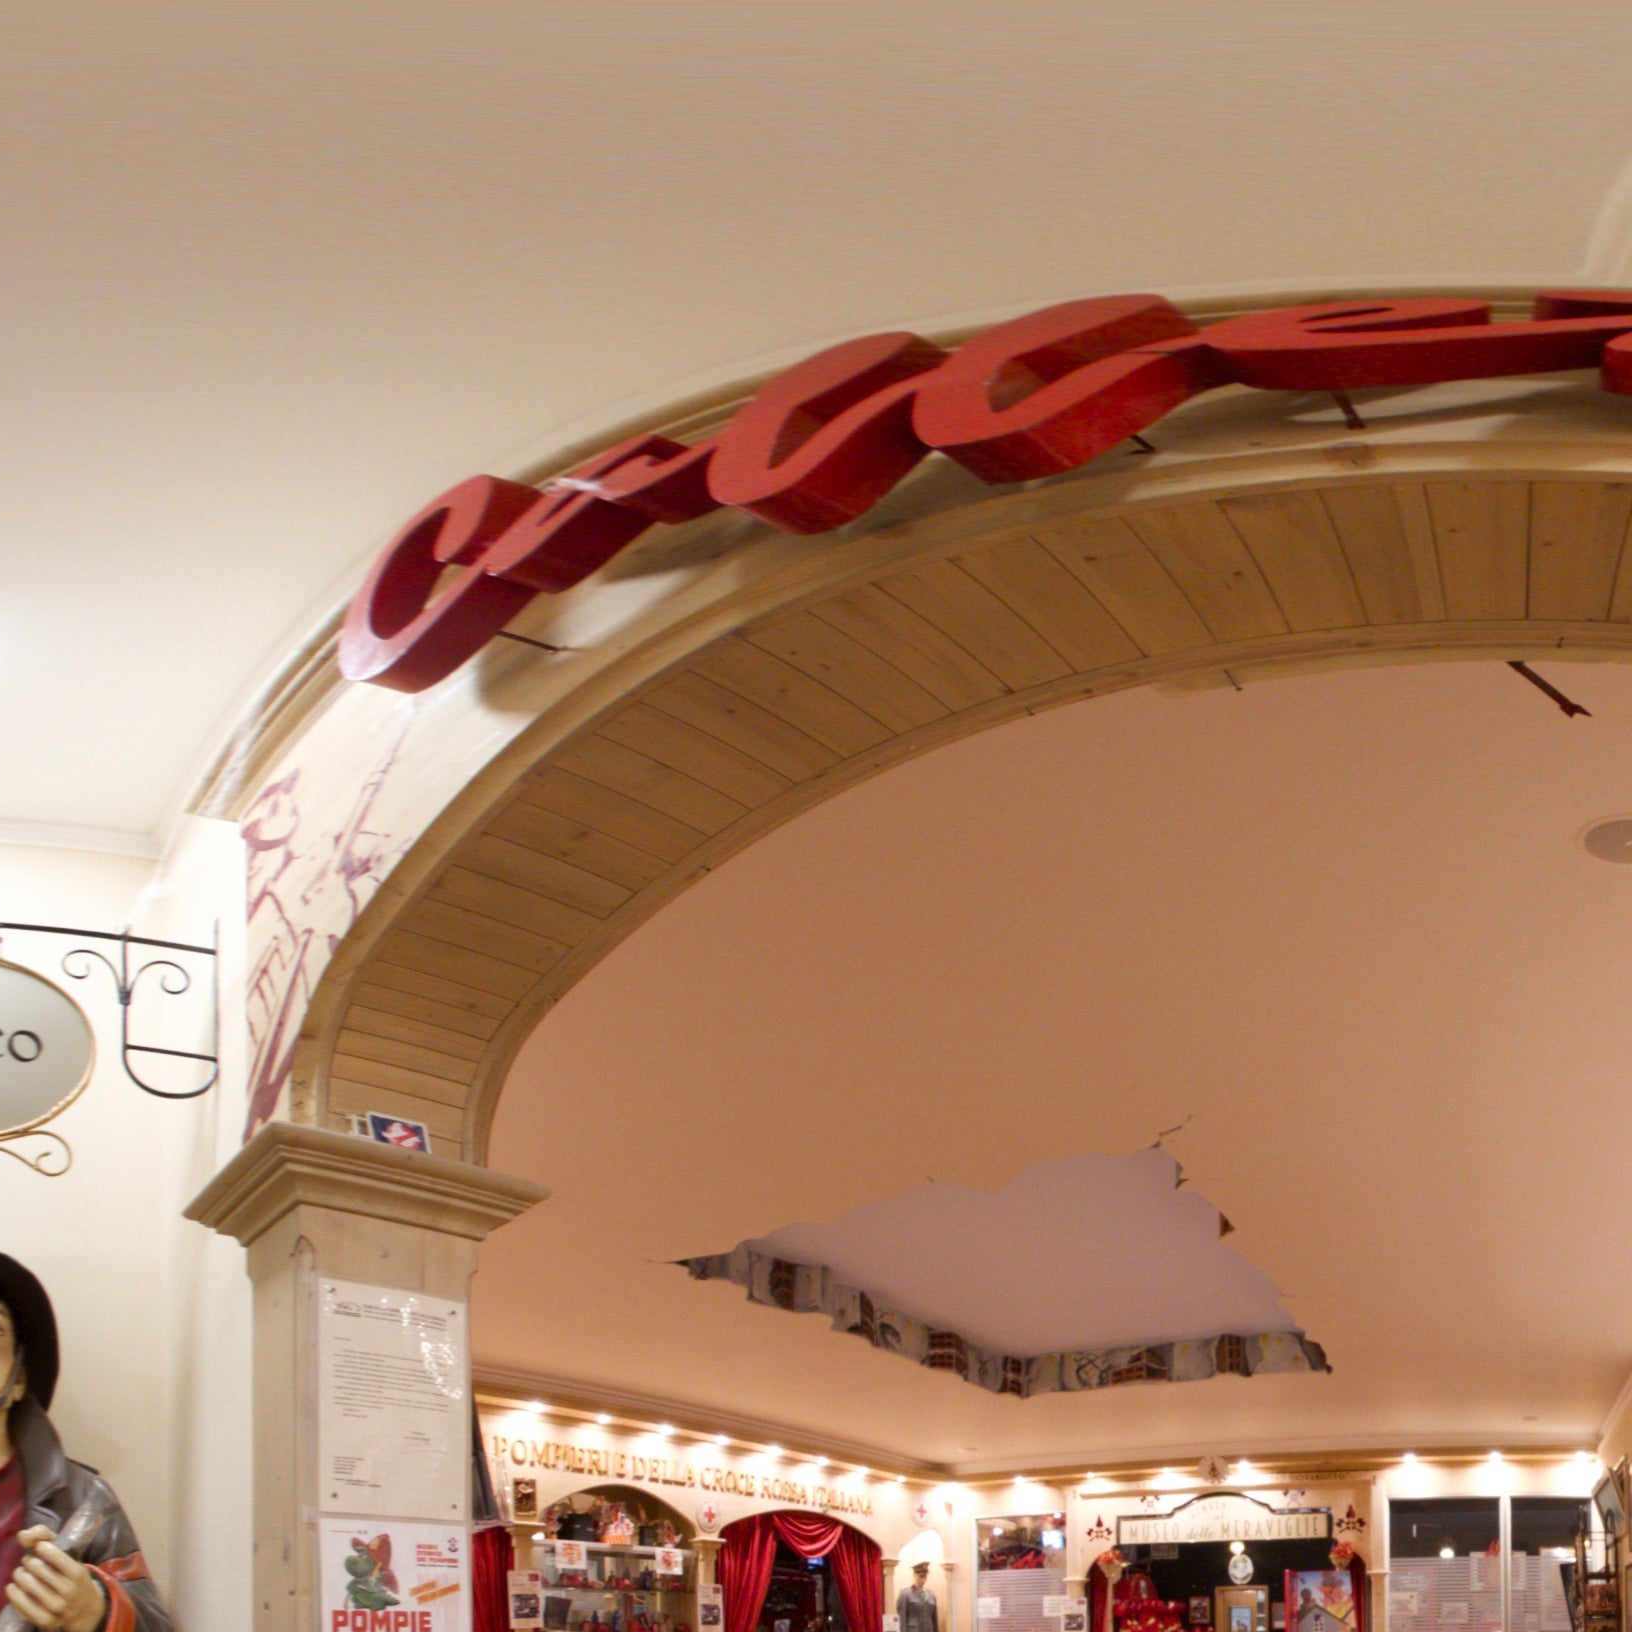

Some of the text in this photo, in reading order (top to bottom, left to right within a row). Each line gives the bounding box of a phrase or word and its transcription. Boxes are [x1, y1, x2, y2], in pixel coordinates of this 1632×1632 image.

[494, 1436, 610, 1475] POMPIERI
[632, 1454, 694, 1486] DELLA
[701, 1468, 756, 1495] CROCE
[761, 1476, 807, 1502] ROSSA
[812, 1483, 873, 1515] ITALIANA
[1129, 1523, 1180, 1542] MUSEO
